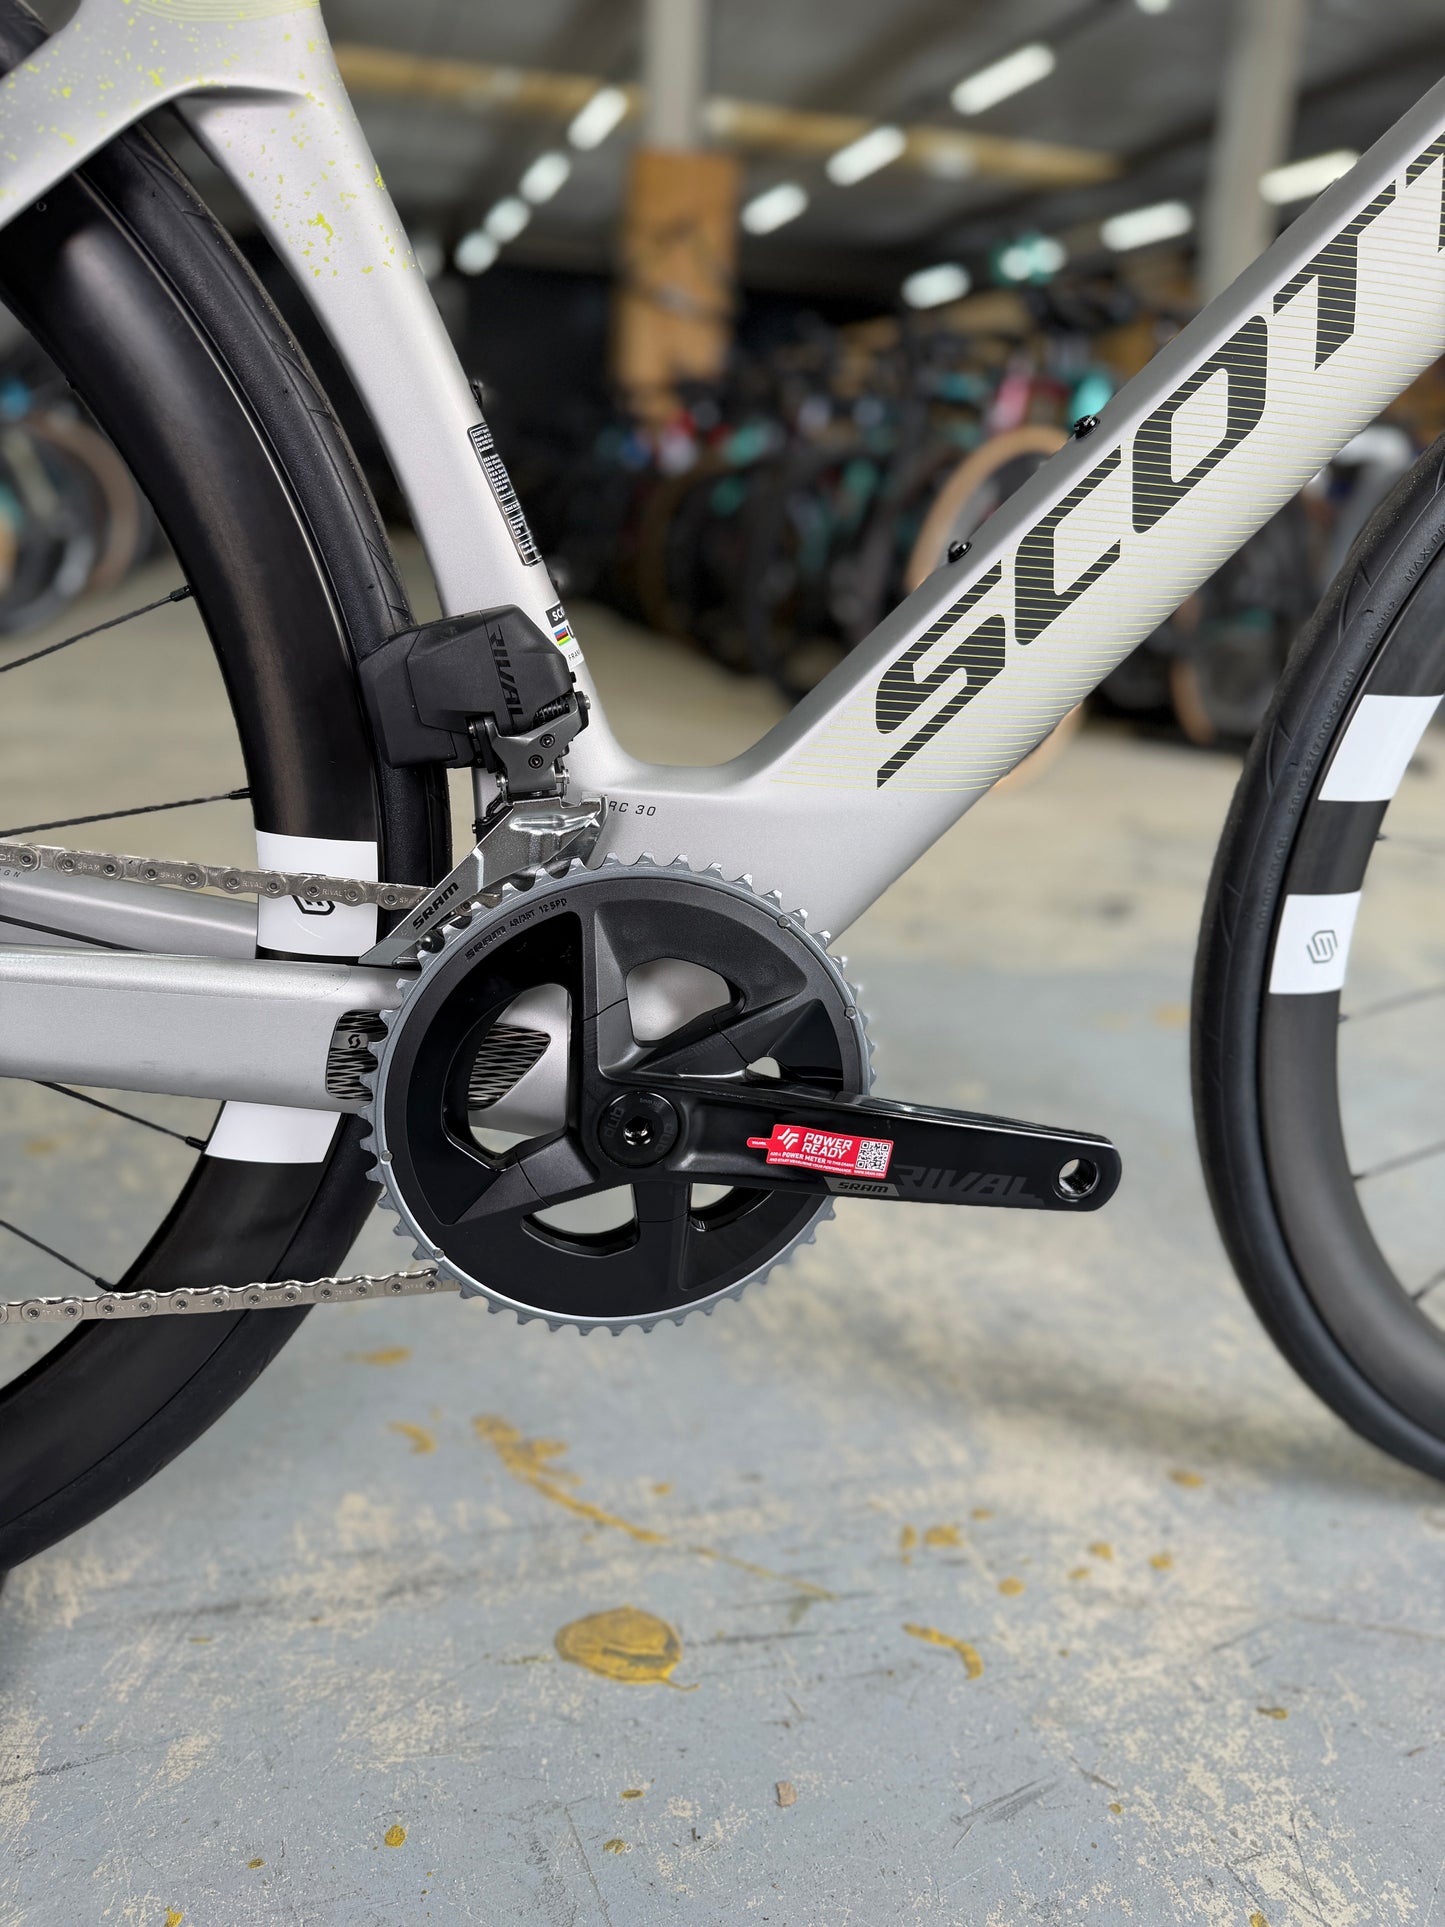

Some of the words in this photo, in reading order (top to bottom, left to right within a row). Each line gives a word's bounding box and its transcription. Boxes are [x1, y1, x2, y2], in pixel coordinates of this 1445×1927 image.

[490, 624, 524, 728] RIVAL
[635, 805, 656, 816] 30
[77, 863, 100, 871] SRAM
[158, 871, 184, 880] SRAM
[242, 881, 264, 889] RIVAL
[412, 881, 459, 930] SRAM
[538, 903, 550, 915] 12
[550, 898, 568, 911] SPD
[803, 1132, 853, 1150] POWER
[781, 1151, 803, 1160] POWER
[804, 1155, 826, 1163] METER
[801, 1143, 848, 1159] READY
[838, 1181, 889, 1193] SRAM
[893, 1164, 1041, 1199] RIVAL
